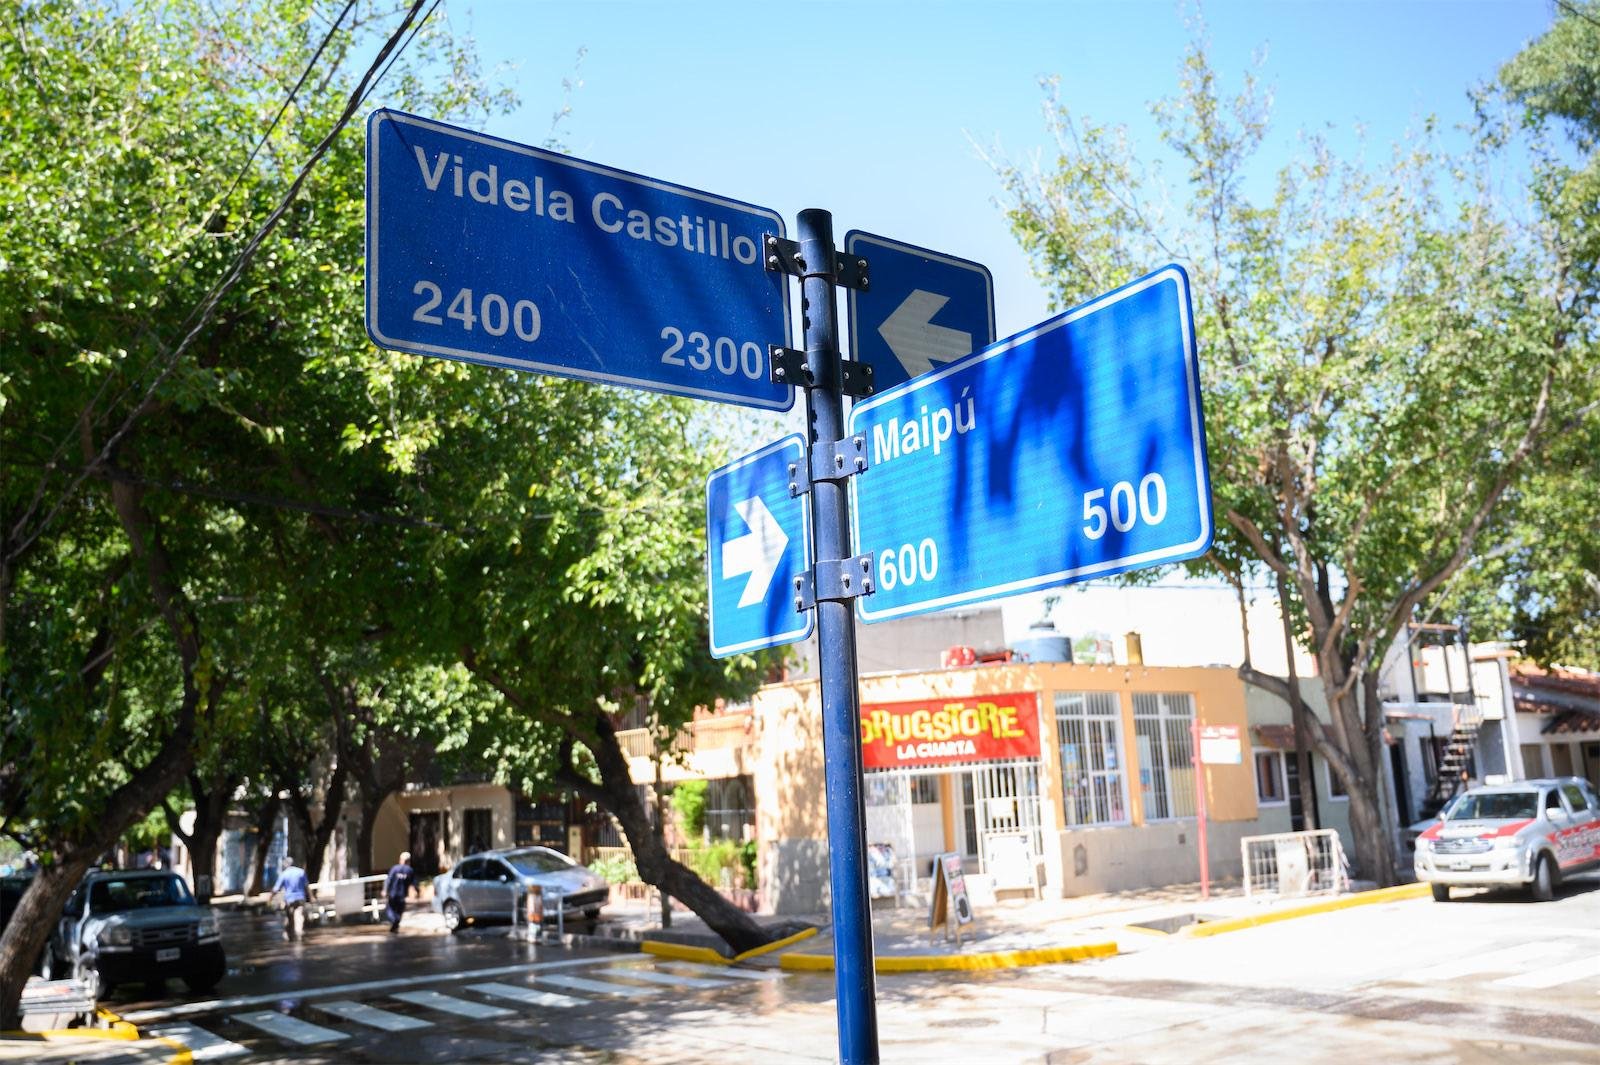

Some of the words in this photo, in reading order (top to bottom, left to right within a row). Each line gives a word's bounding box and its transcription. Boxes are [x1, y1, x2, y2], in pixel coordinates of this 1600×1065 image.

[413, 145, 575, 224] Videla
[592, 192, 757, 265] Castillo
[412, 280, 541, 342] 2400
[660, 326, 763, 380] 2300
[873, 386, 976, 465] Maipú
[879, 537, 938, 591] 600
[1082, 472, 1167, 540] 500
[897, 744, 916, 760] LA
[916, 740, 976, 758] CUARTA
